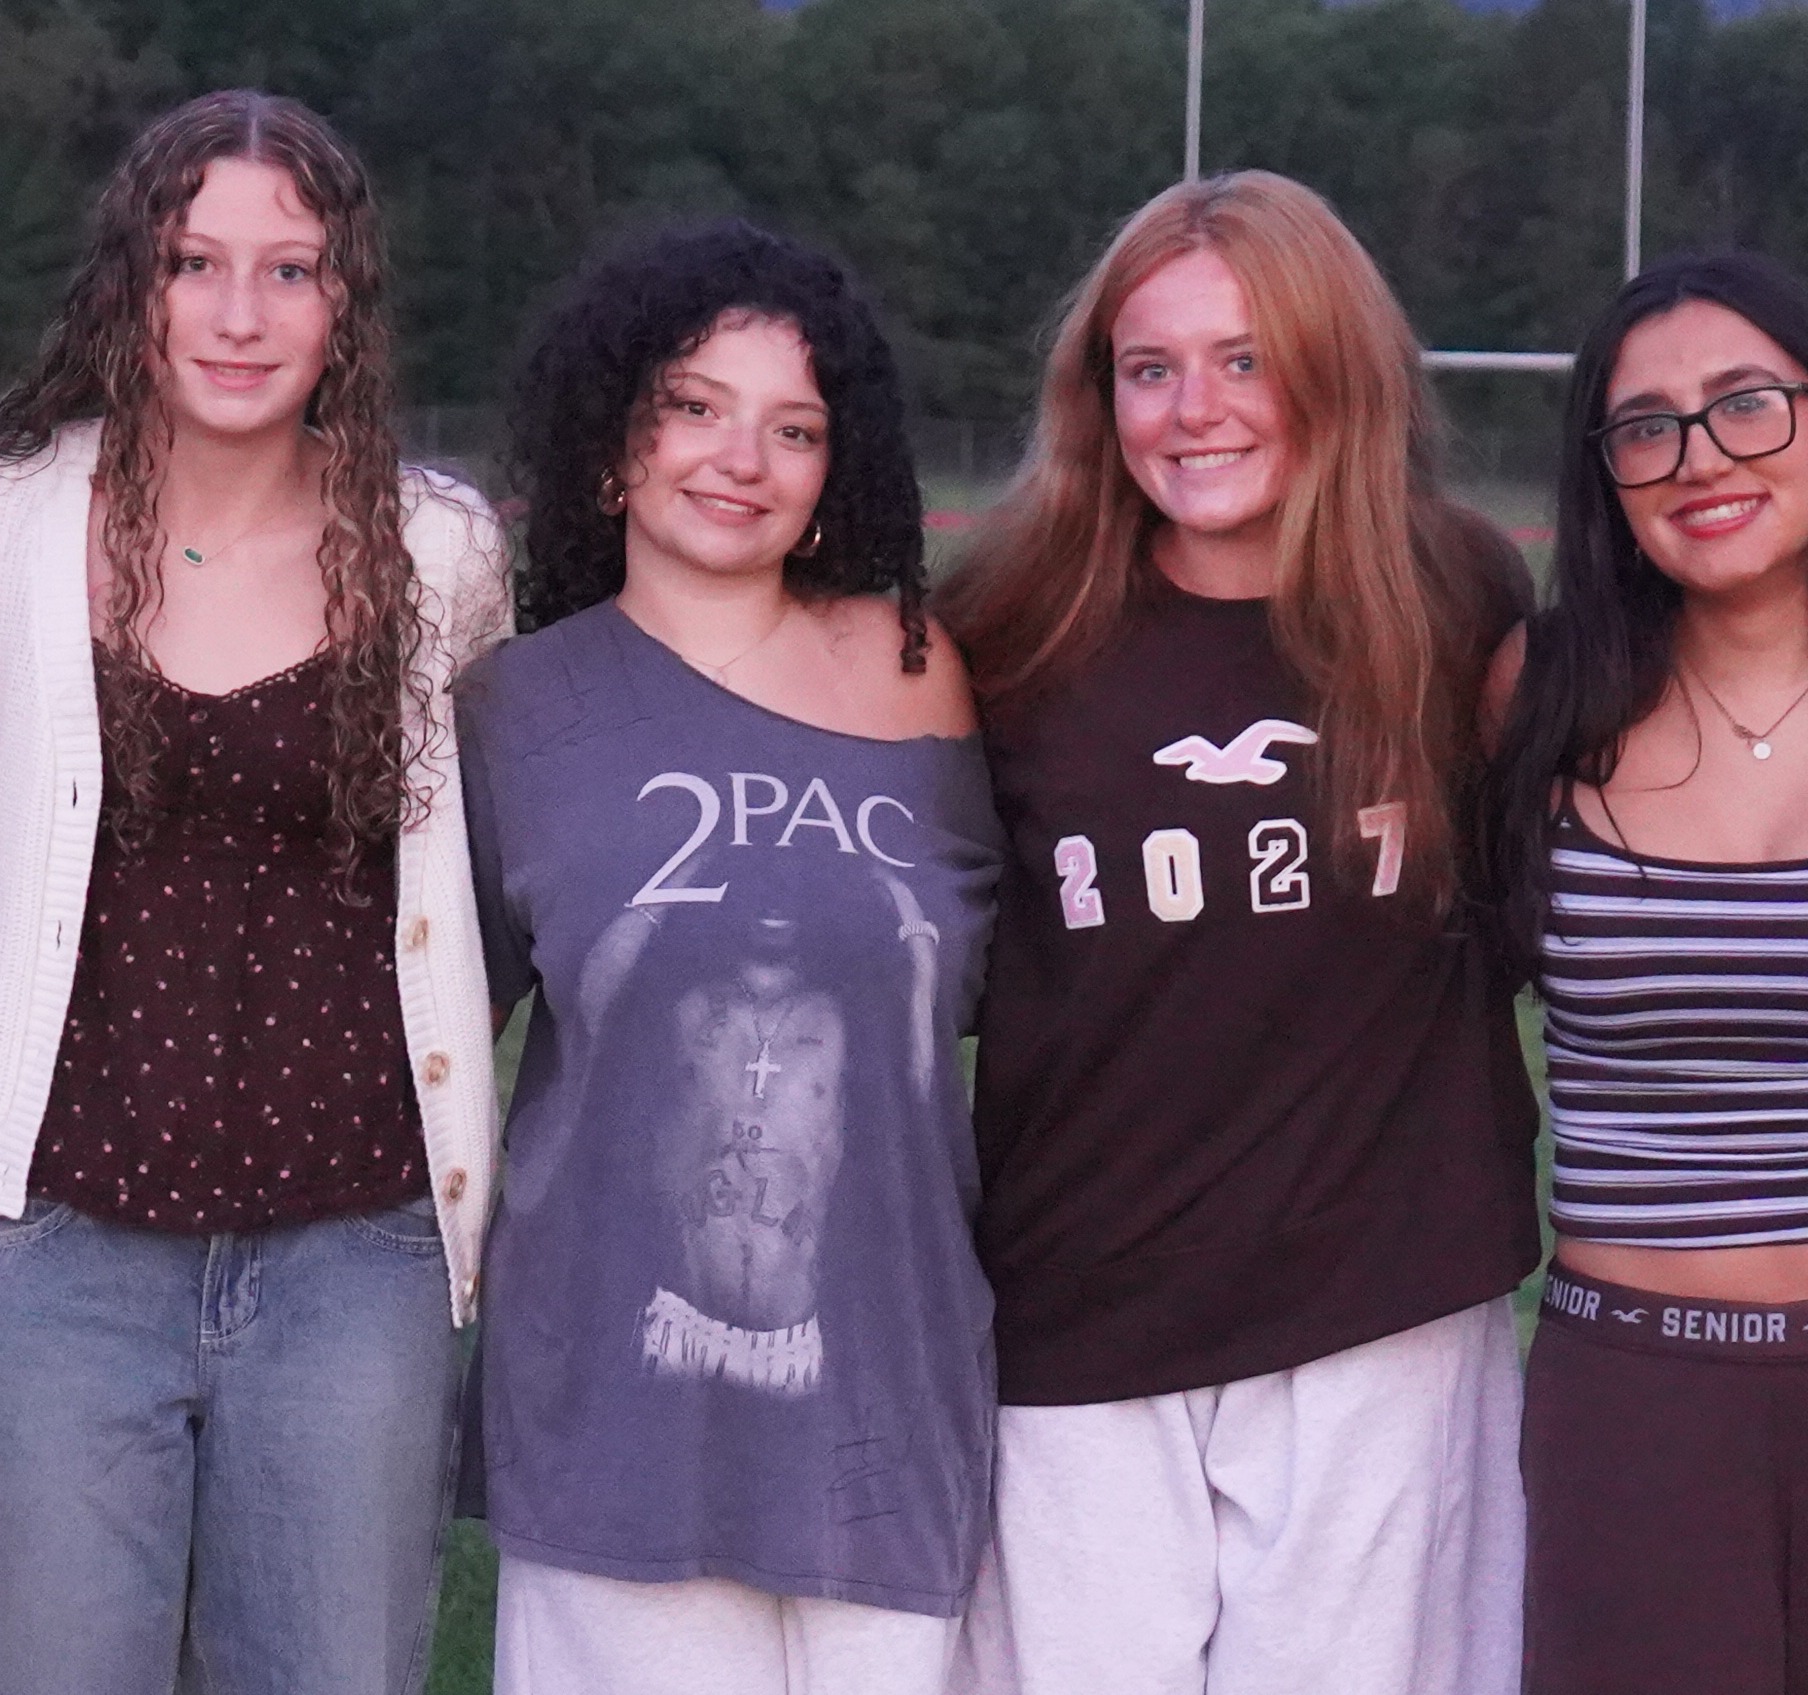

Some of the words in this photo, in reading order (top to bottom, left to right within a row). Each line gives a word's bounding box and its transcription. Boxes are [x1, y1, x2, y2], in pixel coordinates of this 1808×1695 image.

[624, 772, 916, 907] 2PAC
[1054, 802, 1407, 930] 2027
[1545, 1275, 1601, 1321] NIOR
[1661, 1307, 1787, 1343] SENIOR
